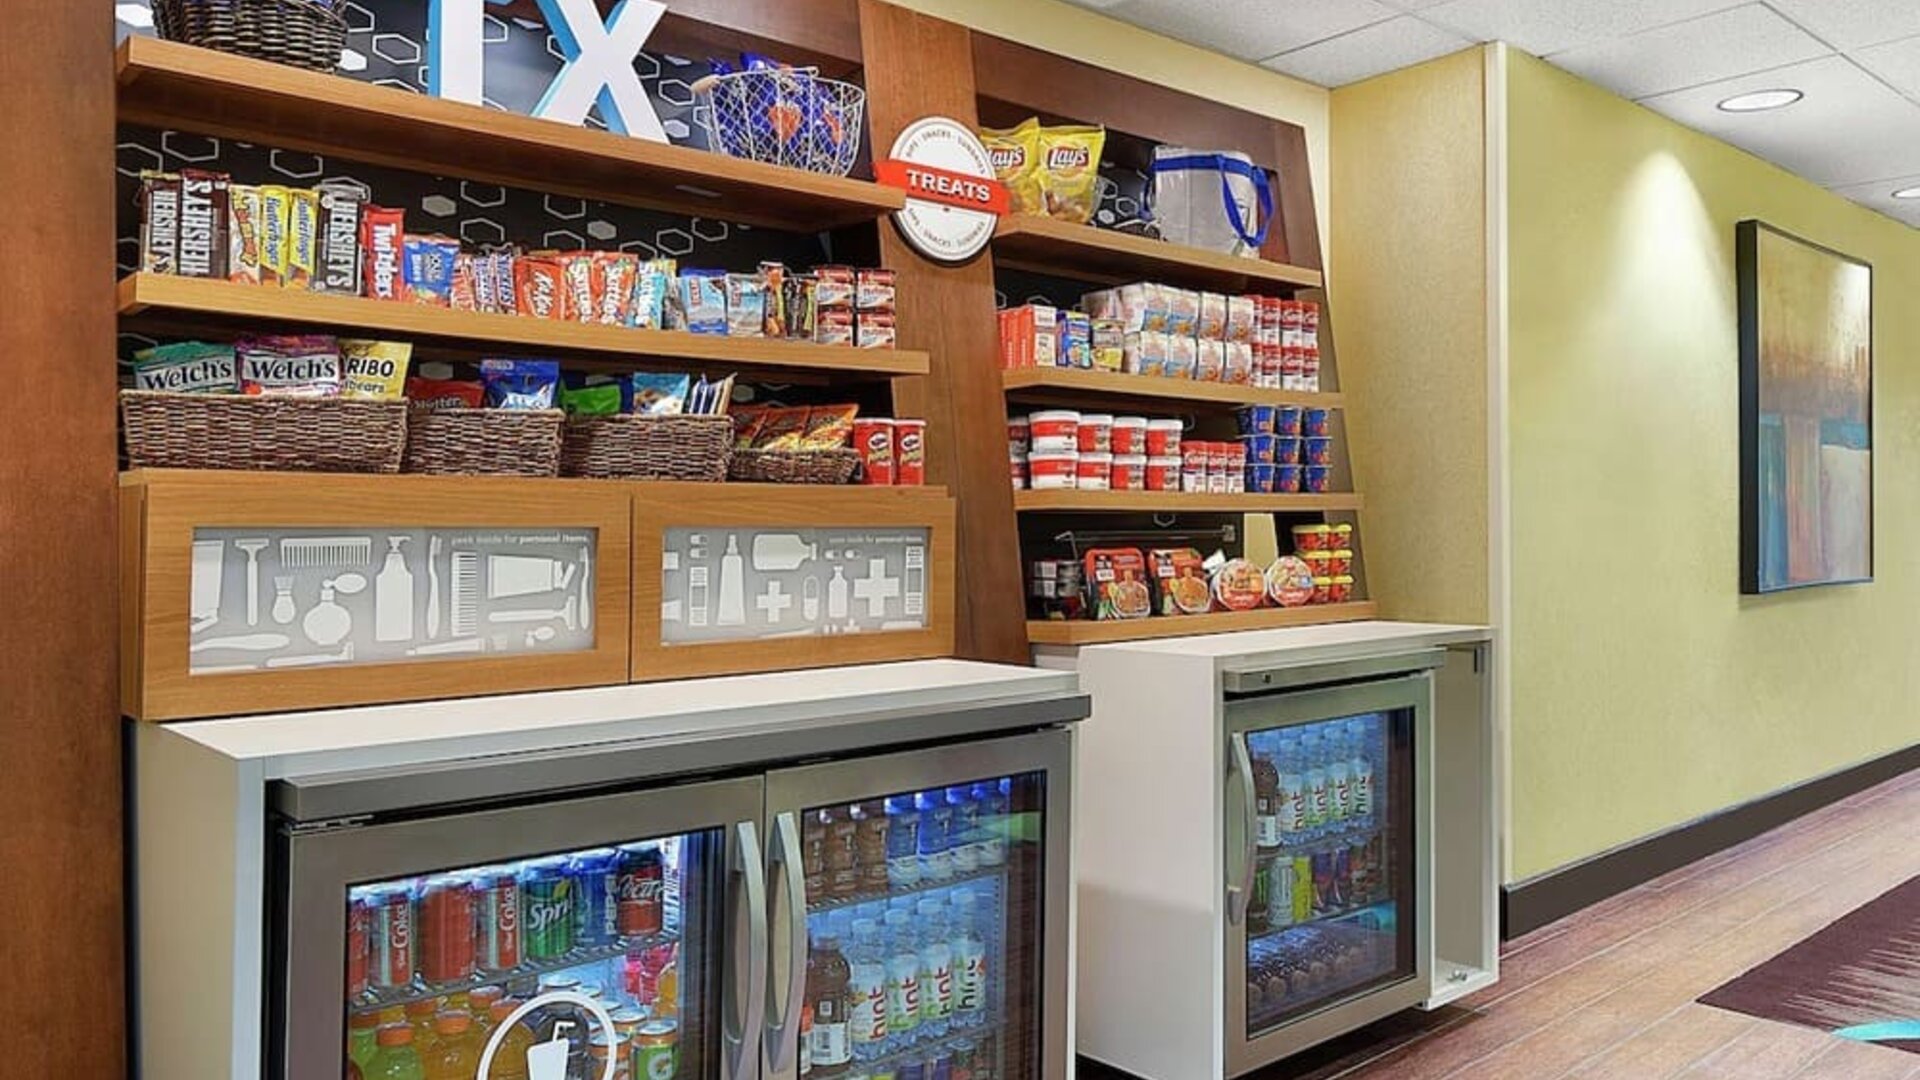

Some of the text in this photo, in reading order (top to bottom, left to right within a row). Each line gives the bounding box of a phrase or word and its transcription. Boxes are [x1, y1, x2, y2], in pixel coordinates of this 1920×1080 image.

[1050, 145, 1088, 167] Lay's
[906, 169, 991, 202] TREATS
[143, 361, 231, 389] Welch's
[251, 359, 336, 380] Welch's
[347, 358, 394, 377] RIBO
[1314, 786, 1327, 813] int
[499, 887, 516, 931] Coke
[605, 875, 617, 935] PEPSI
[391, 905, 410, 948] Coke
[868, 984, 886, 1039] hint
[902, 976, 920, 1016] int
